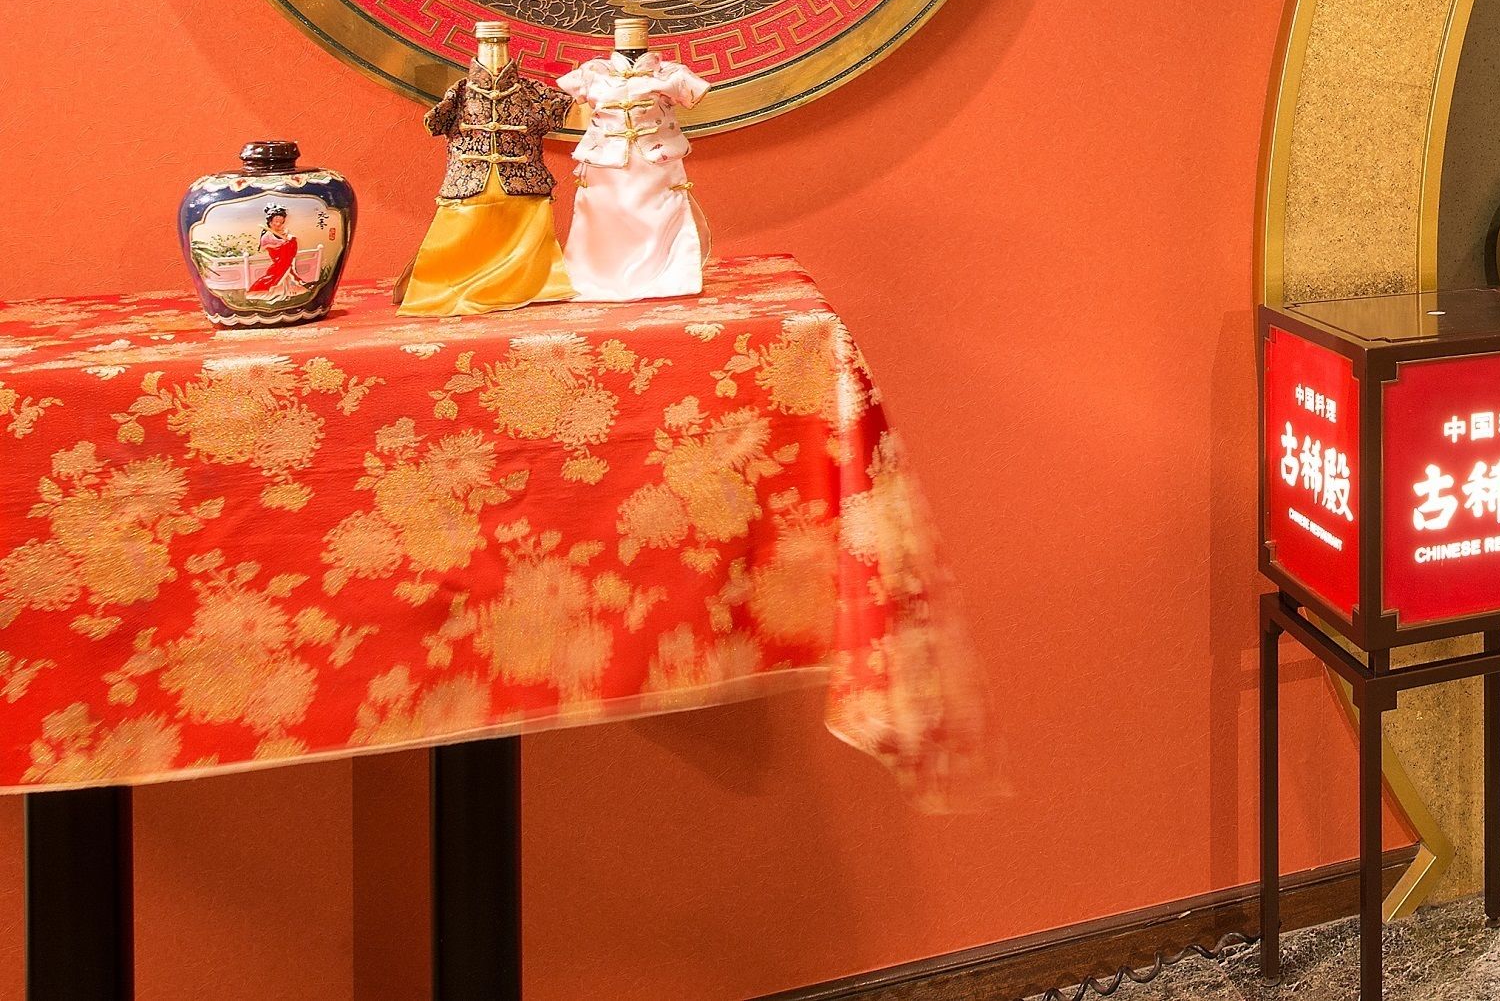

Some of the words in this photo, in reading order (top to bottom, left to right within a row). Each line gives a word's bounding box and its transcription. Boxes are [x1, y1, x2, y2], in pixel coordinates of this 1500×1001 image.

[1280, 421, 1354, 522] 古稀殿
[1414, 539, 1482, 564] CHINESE
